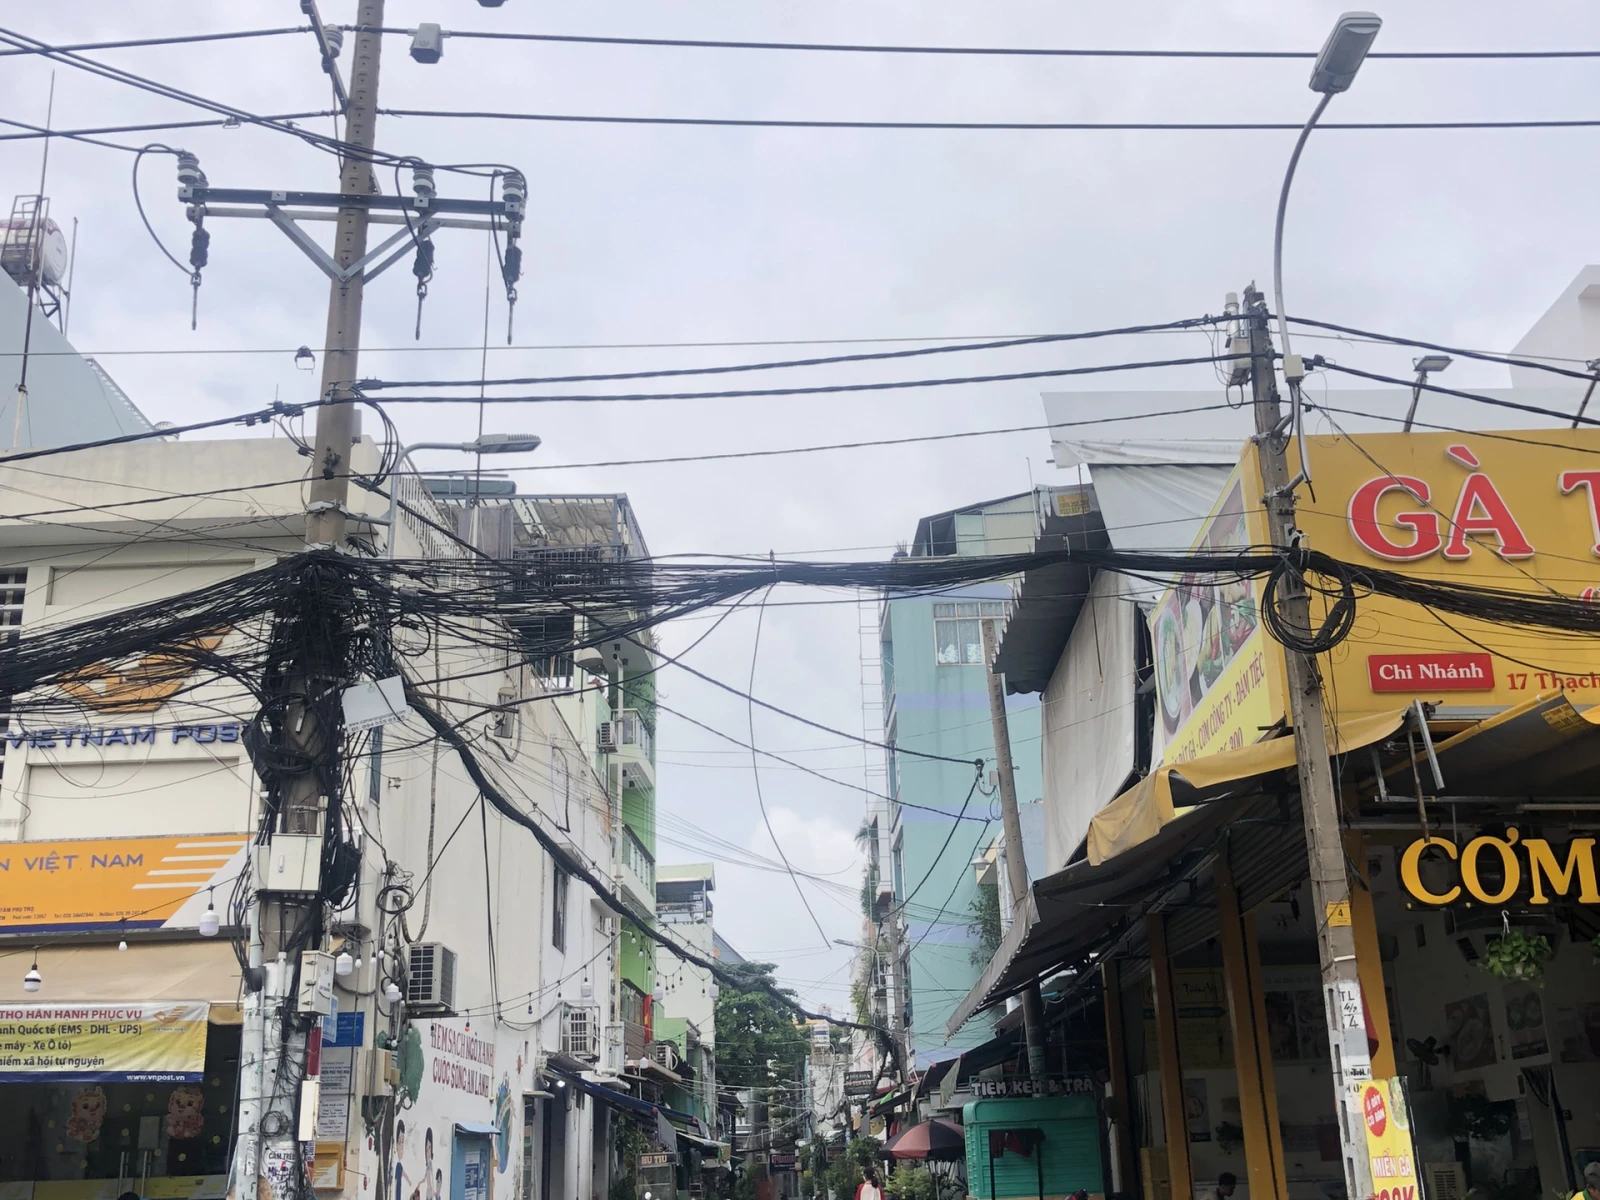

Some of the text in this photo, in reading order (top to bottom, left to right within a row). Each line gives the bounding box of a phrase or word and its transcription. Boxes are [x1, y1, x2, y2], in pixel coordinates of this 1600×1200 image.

[1347, 444, 1536, 562] GÀ
[1378, 662, 1485, 681] Chi Nhánh
[1507, 673, 1528, 691] 17
[6, 724, 242, 749] VIETNAM POS
[24, 850, 78, 874] VIỆT
[91, 854, 144, 869] NAM
[1400, 825, 1600, 905] CƠM
[0, 1009, 23, 1021] THỌ
[55, 1009, 88, 1020] HẠNH
[92, 1009, 125, 1020] PHỤC
[126, 1009, 142, 1020] VỤ
[18, 1023, 44, 1036] Quốc
[45, 1023, 56, 1035] tế
[58, 1025, 83, 1036] (EMS
[90, 1025, 111, 1035] DHL
[118, 1025, 142, 1036] UPS)
[5, 1040, 25, 1053] máy
[33, 1040, 45, 1050] Xe
[23, 1055, 35, 1066] xã
[37, 1055, 53, 1068] hội
[55, 1057, 68, 1067] tự
[68, 1055, 105, 1069] nguyện
[971, 1078, 1007, 1098] TIỆM
[1013, 1079, 1042, 1094] KEM
[1048, 1078, 1059, 1093] &
